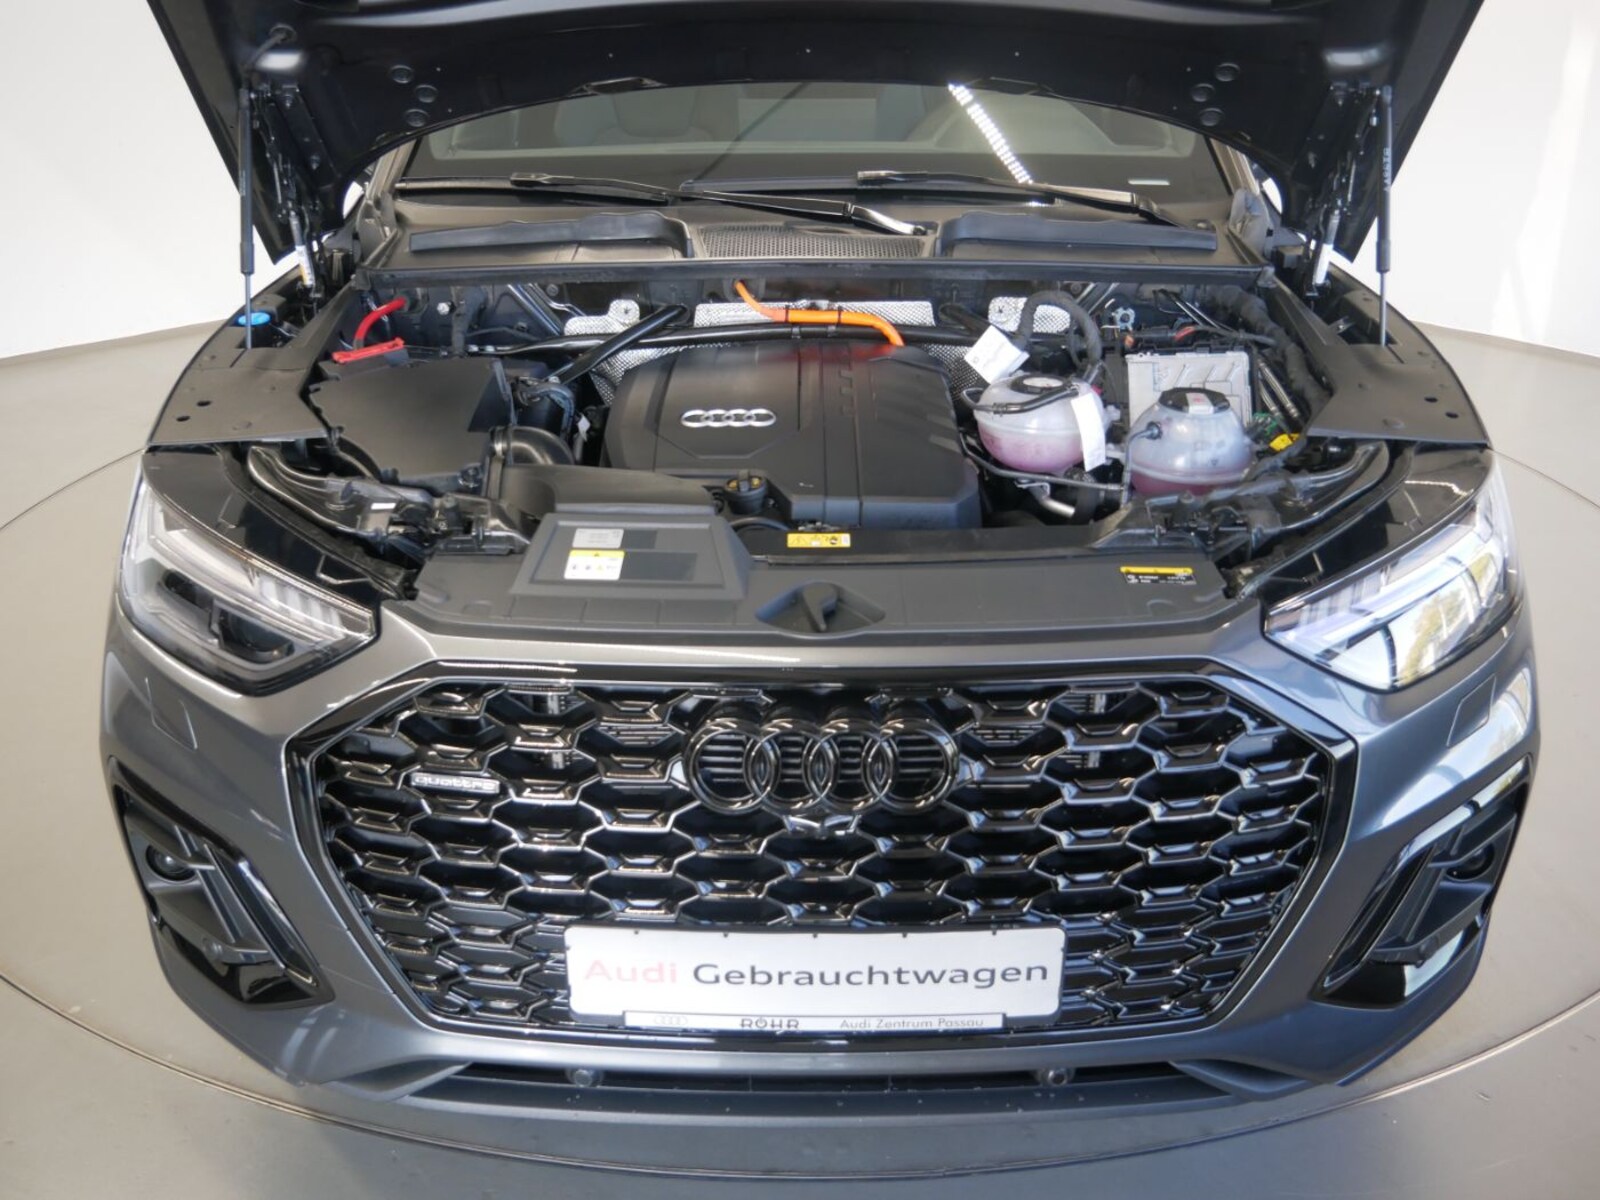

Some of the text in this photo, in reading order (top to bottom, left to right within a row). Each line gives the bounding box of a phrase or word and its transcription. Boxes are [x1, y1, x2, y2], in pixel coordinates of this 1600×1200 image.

[414, 774, 495, 791] quattro
[584, 959, 1048, 989] Audi Gebrauchtwagen
[840, 1019, 871, 1029] Audi
[876, 1019, 932, 1029] Zentrum
[938, 1017, 984, 1028] Passau
